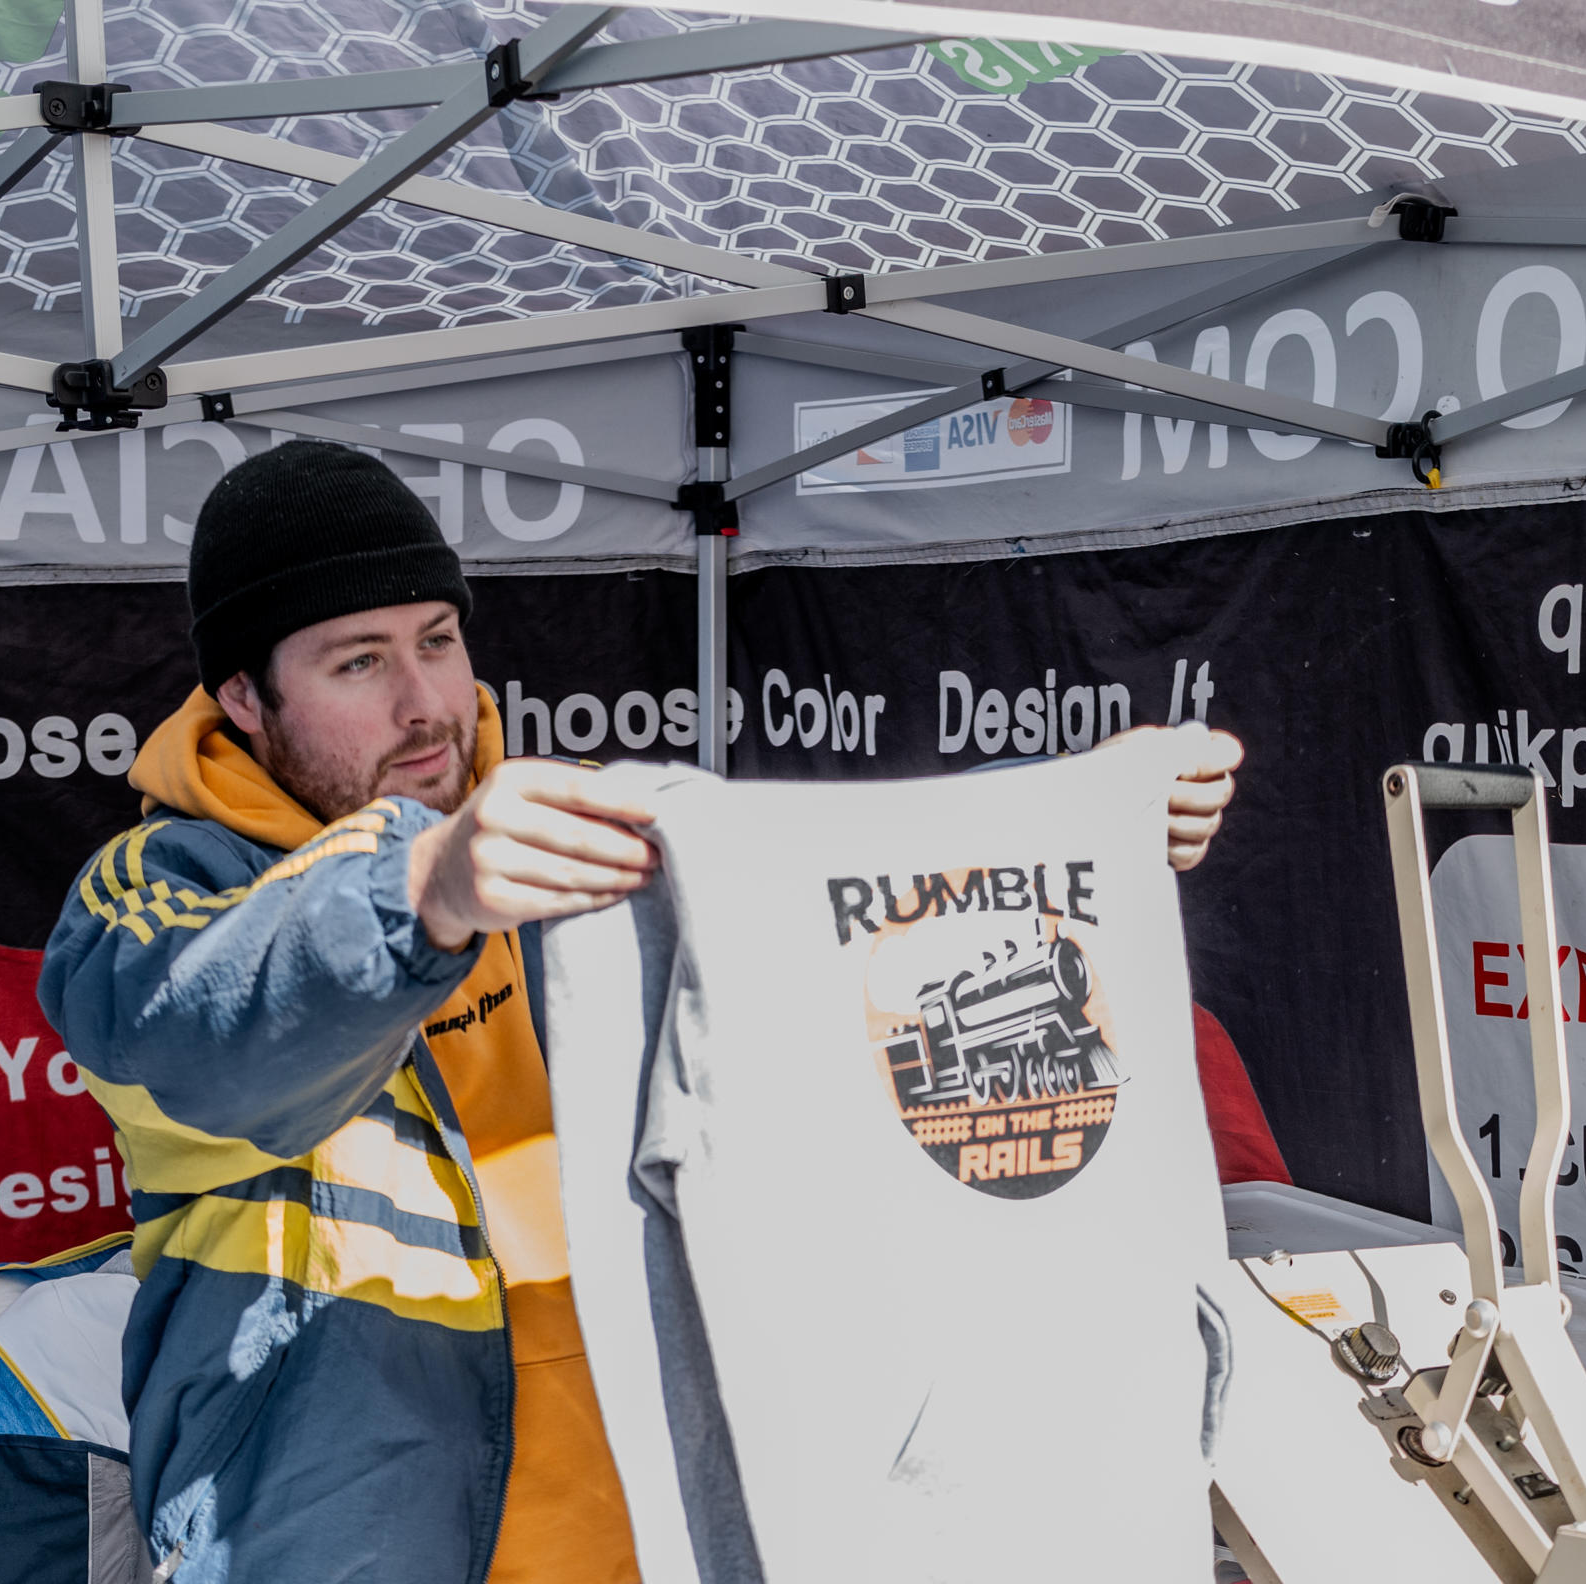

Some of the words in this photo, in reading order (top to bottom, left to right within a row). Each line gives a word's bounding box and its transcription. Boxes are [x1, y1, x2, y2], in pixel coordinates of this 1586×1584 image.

[477, 678, 745, 757] hoose
[763, 667, 886, 756] Color
[938, 668, 1131, 755] Design
[826, 860, 1099, 947] RUMBLE
[958, 1130, 1085, 1185] RAILS
[975, 1115, 1007, 1139] ON
[1009, 1109, 1053, 1134] THE
